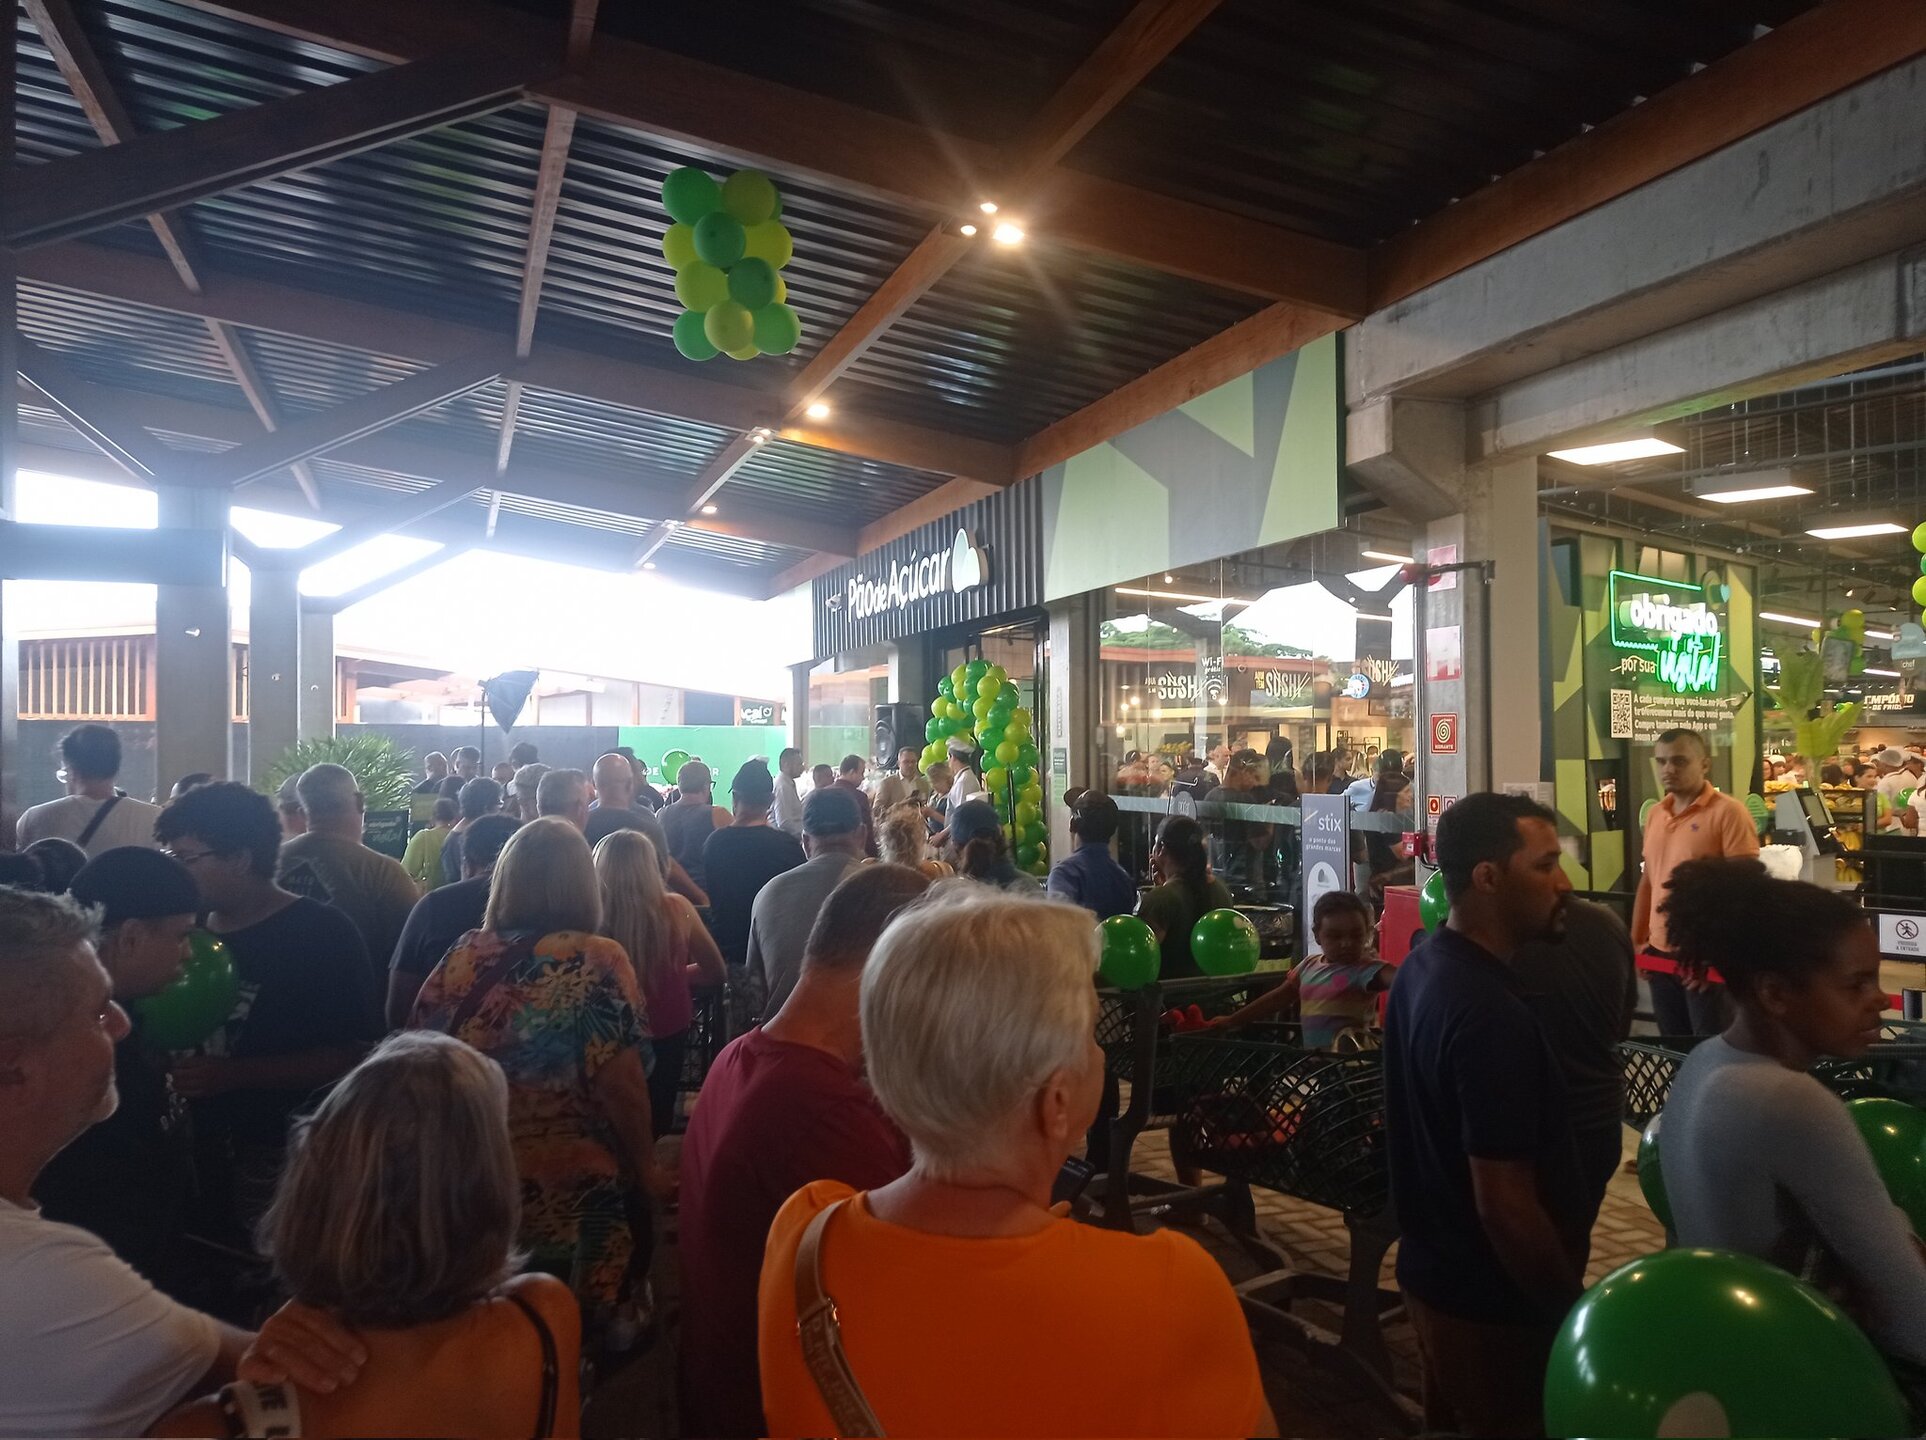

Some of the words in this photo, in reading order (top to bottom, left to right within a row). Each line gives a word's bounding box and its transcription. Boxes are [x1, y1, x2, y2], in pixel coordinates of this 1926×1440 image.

[848, 573, 874, 623] Pão
[874, 577, 888, 615] de
[888, 547, 951, 611] Açúcar
[1627, 593, 1719, 640] obrigado
[1621, 657, 1637, 675] por
[1639, 659, 1656, 674] sua
[1318, 812, 1342, 833] stix
